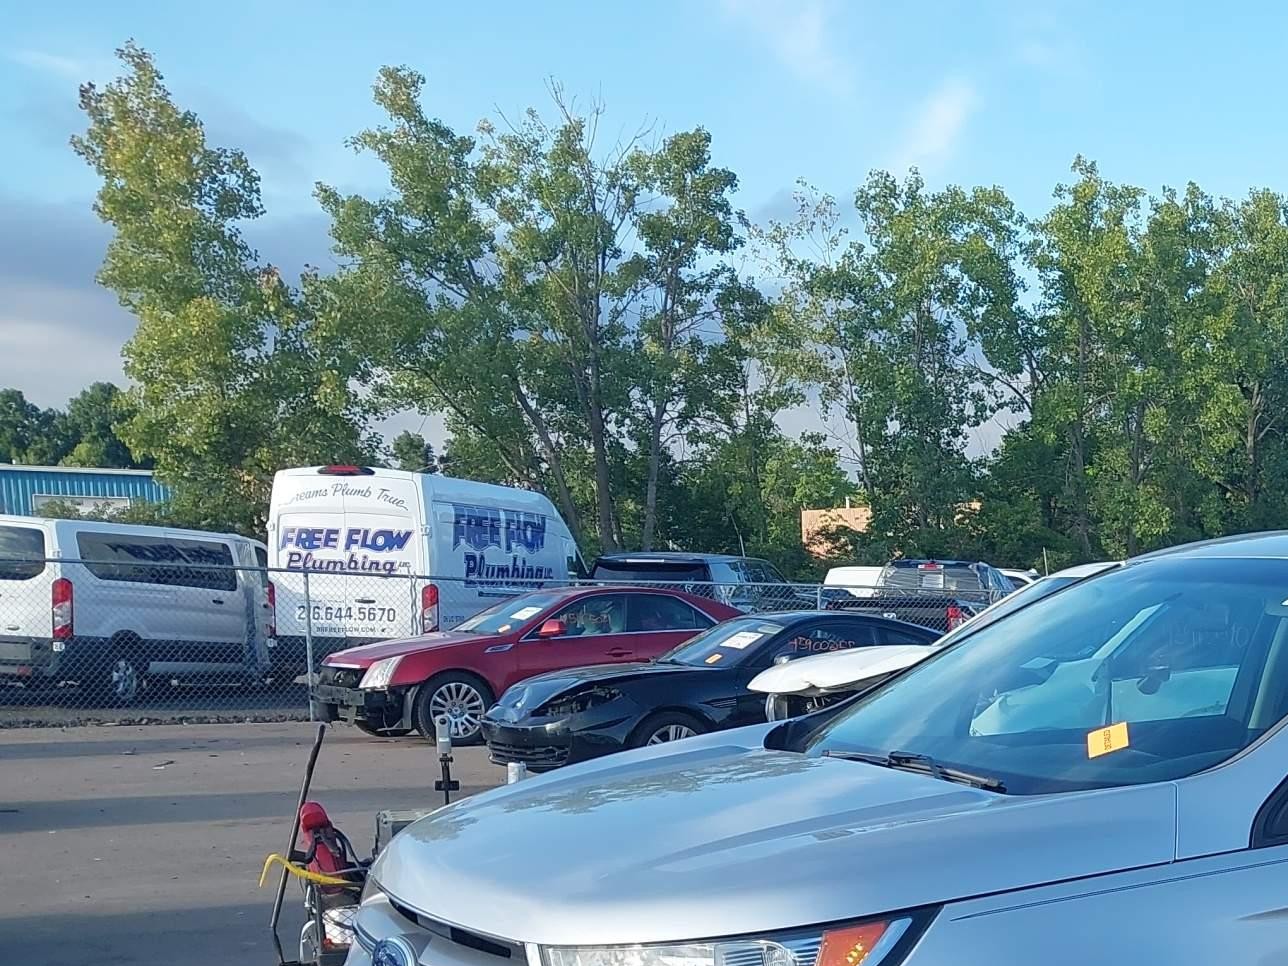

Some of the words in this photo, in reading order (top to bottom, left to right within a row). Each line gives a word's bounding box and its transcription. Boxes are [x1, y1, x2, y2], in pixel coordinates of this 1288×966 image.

[331, 482, 372, 498] Plumb
[281, 528, 341, 550] FREE
[343, 528, 416, 553] FLOW
[453, 505, 502, 551] FREE
[504, 510, 547, 554] FLOW
[286, 551, 397, 575] Plumbing
[464, 552, 545, 589] Plumbing
[296, 604, 396, 622] 26.644.5670
